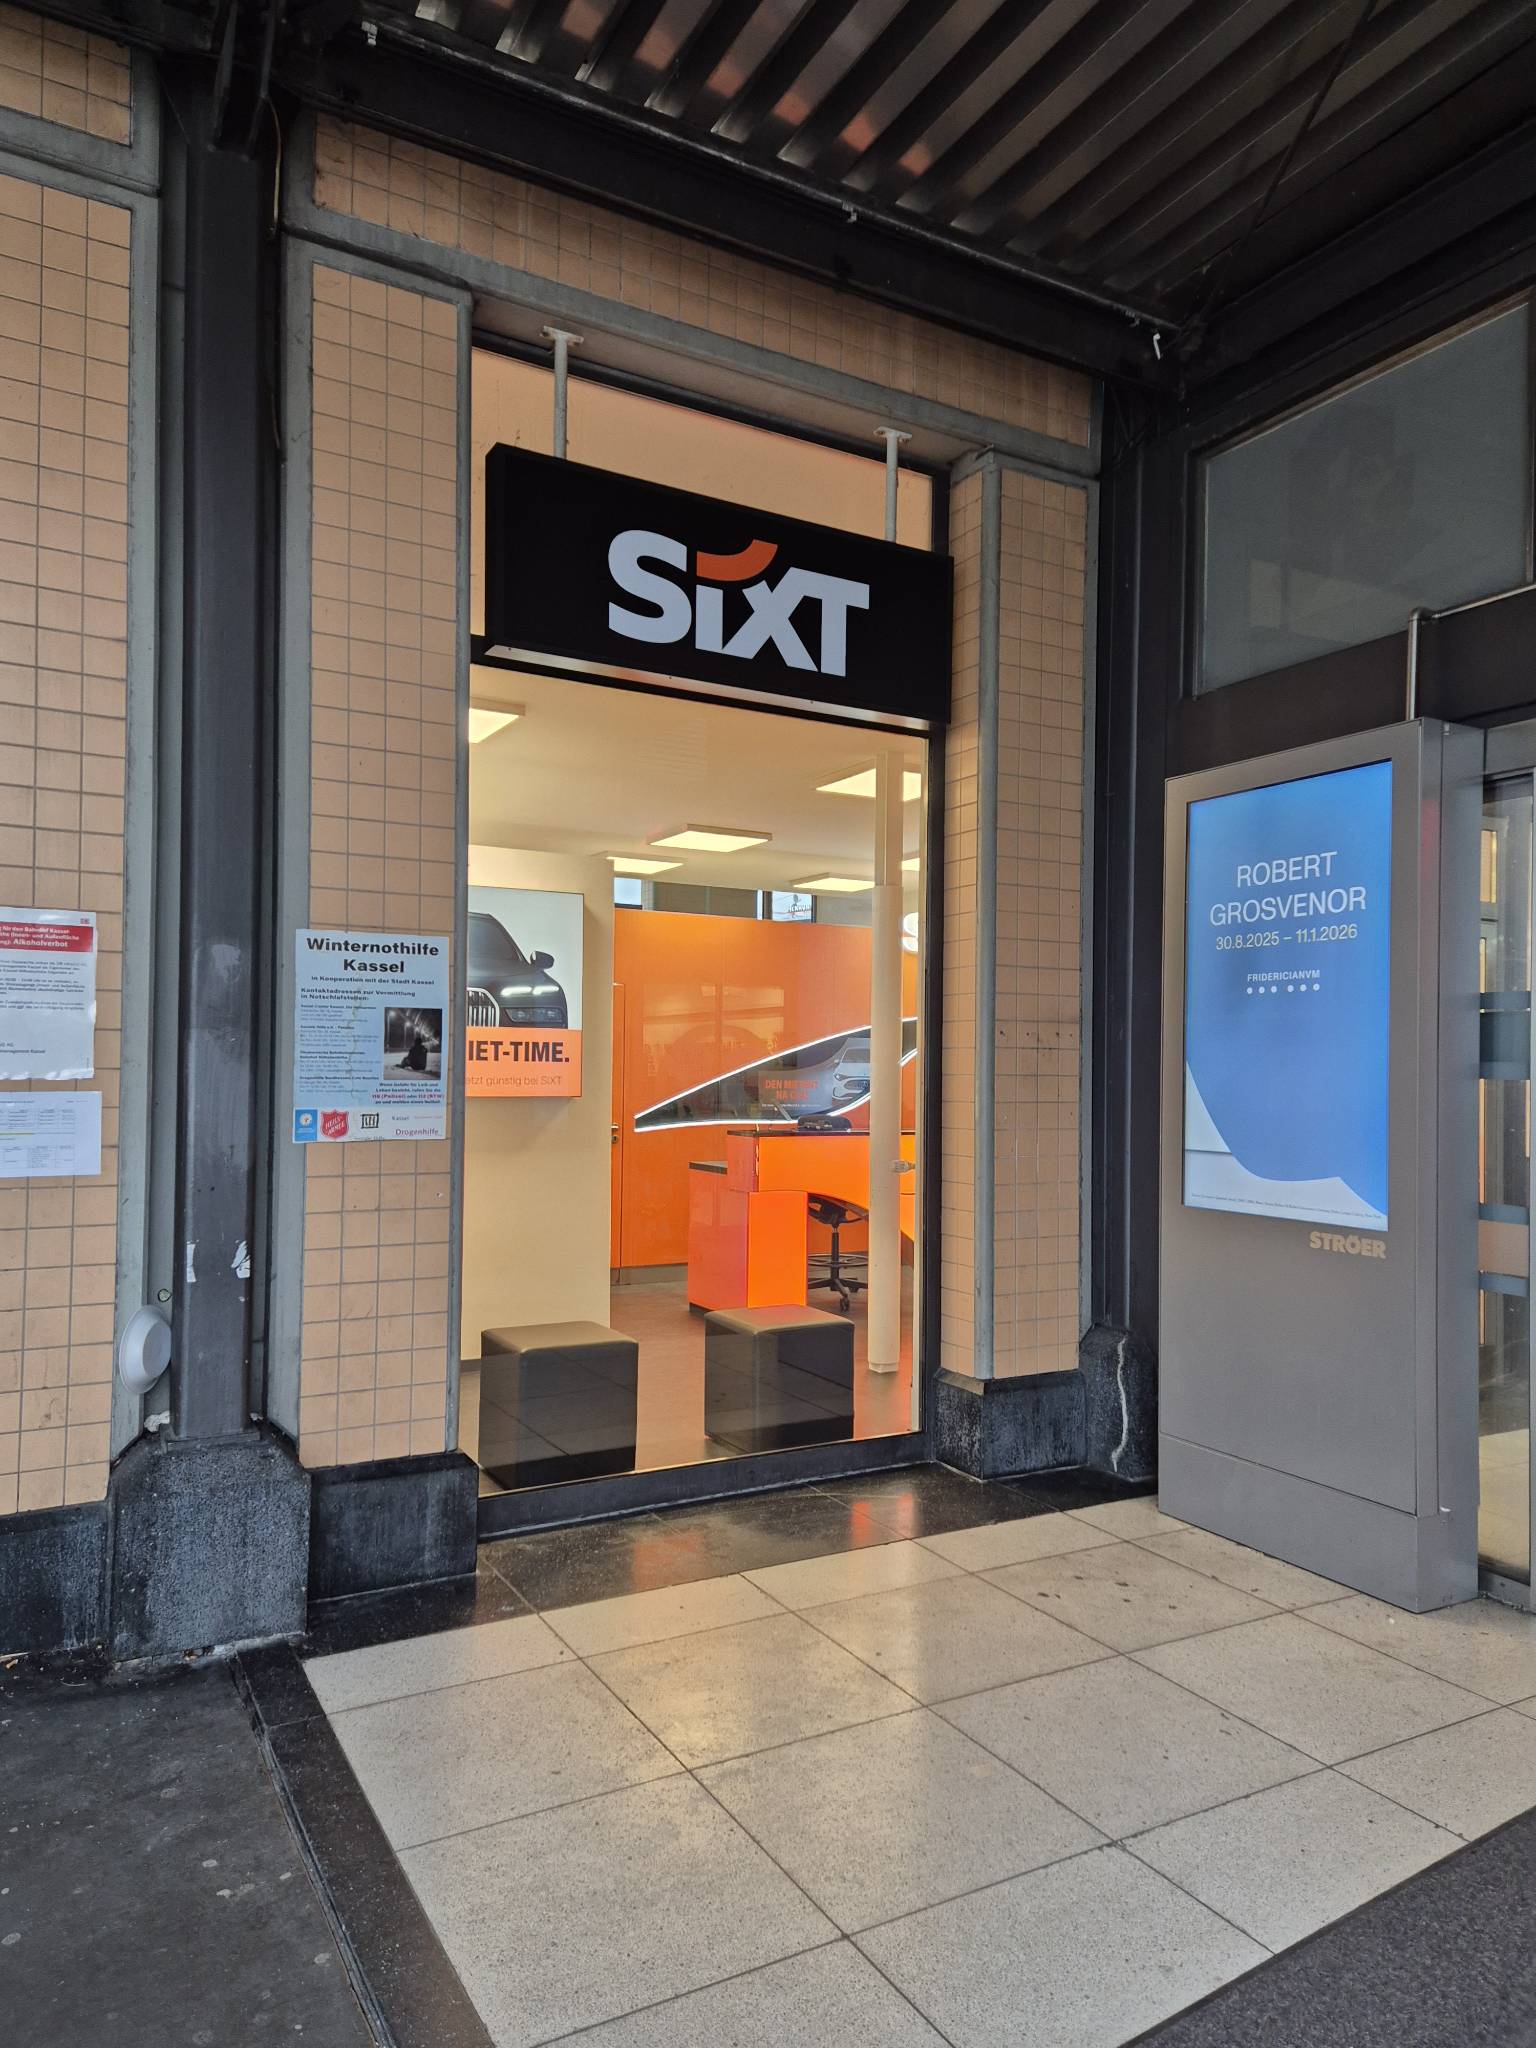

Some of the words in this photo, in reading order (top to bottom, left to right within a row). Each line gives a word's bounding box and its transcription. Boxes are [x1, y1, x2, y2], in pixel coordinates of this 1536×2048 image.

[1237, 851, 1338, 888] ROBERT
[1209, 886, 1367, 926] GROSVENOR
[13, 938, 68, 948] Alkoholverbot
[1216, 931, 1280, 950] 30.8.2025
[1295, 923, 1358, 944] 11.1.2026
[306, 937, 439, 956] Winternothilfe
[343, 958, 405, 973] Kassel
[1247, 969, 1321, 982] FRIDERICIANVM
[300, 987, 362, 995] Kontaktadressen
[486, 1075, 523, 1088] günstig
[523, 1076, 537, 1085] bei
[395, 1128, 439, 1136] Drogenhilfe
[1309, 1230, 1387, 1260] STRÖER
